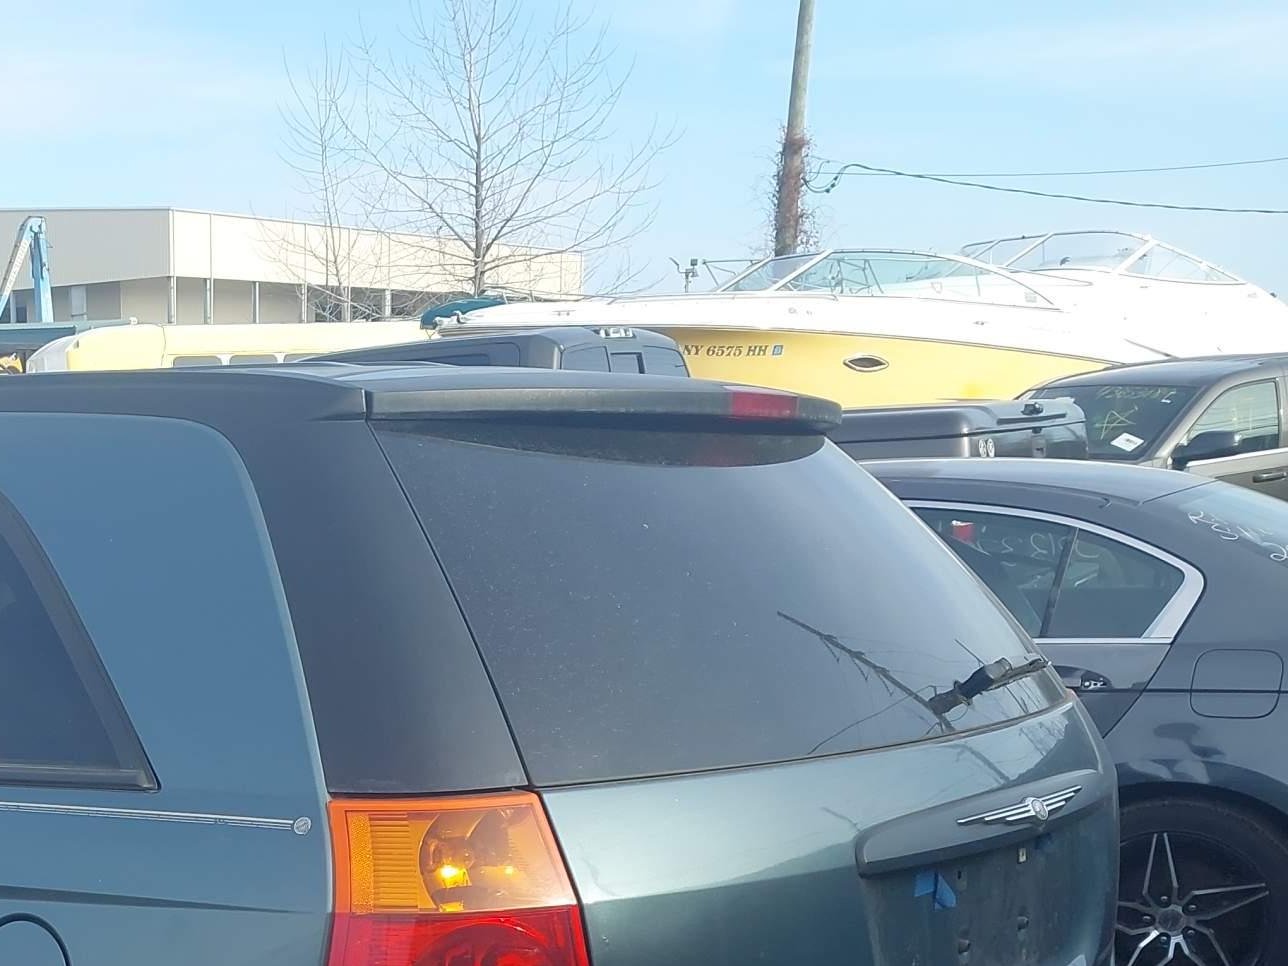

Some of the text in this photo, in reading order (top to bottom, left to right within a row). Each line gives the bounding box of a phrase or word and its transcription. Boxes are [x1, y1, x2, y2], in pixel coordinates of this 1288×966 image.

[683, 344, 768, 357] NY 6575 HH
